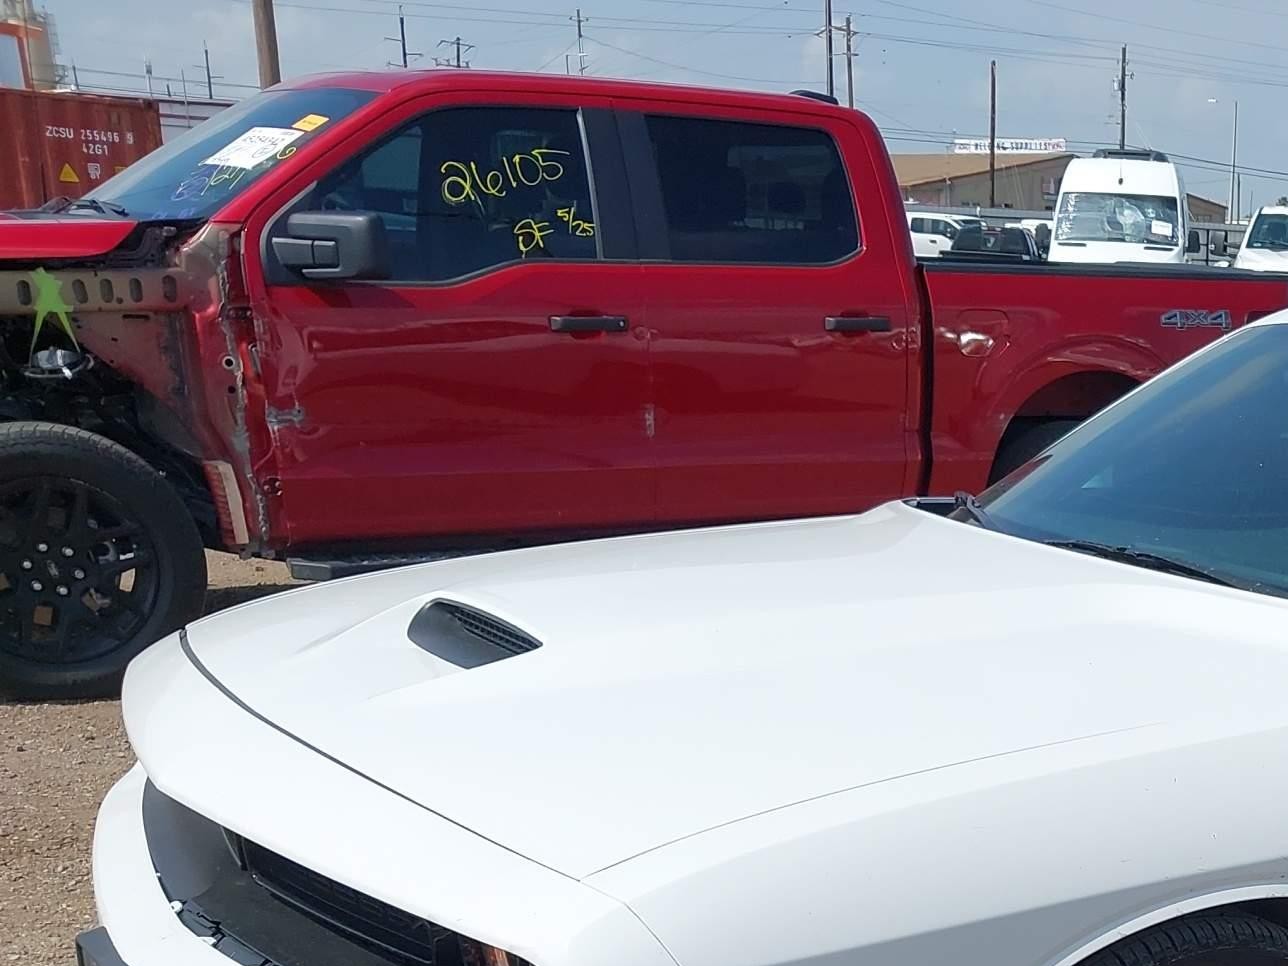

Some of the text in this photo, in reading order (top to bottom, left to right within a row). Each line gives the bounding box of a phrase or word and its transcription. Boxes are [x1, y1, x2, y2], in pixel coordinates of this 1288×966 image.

[45, 126, 74, 139] ZCSU
[82, 143, 108, 155] 42G1
[440, 149, 570, 206] 26105
